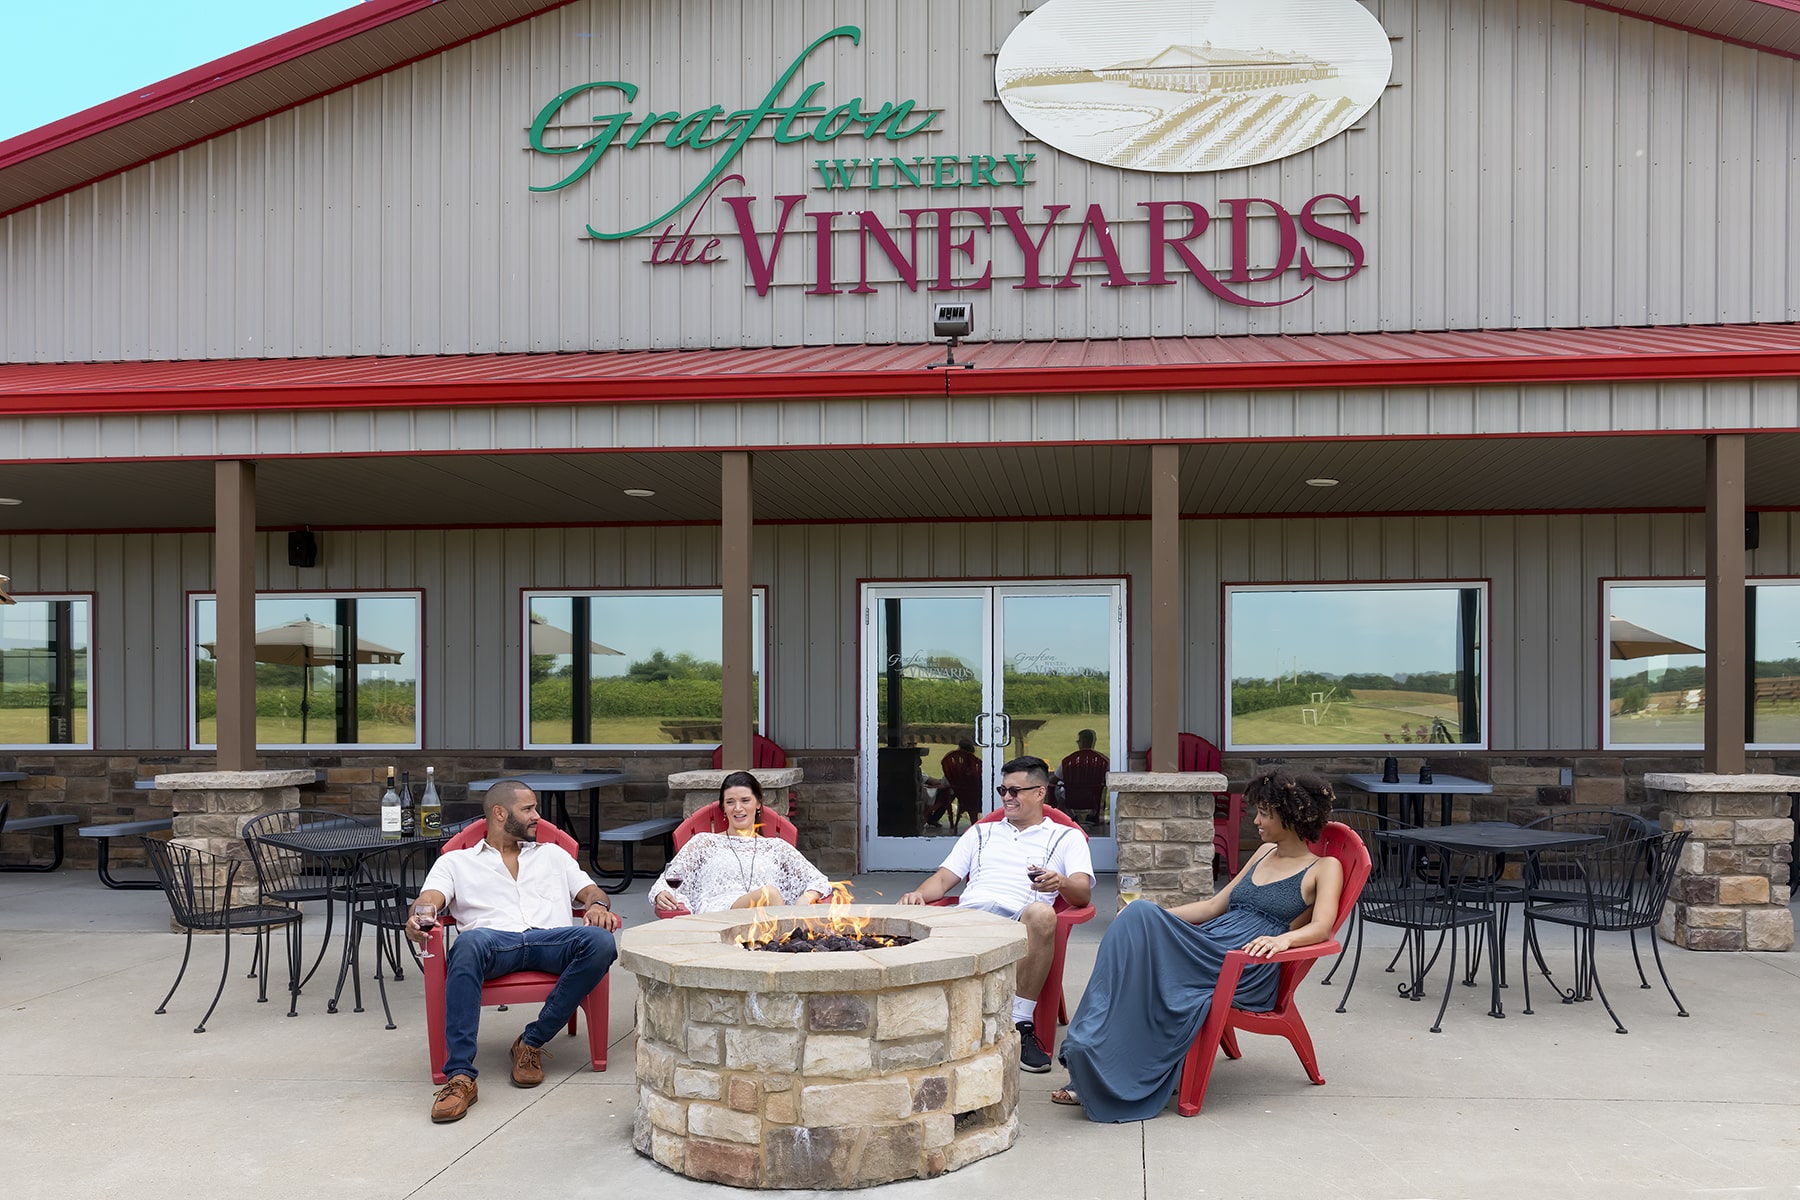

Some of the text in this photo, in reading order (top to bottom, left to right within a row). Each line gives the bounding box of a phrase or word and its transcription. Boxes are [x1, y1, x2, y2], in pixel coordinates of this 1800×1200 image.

[529, 26, 936, 240] Grafton
[816, 153, 1036, 191] WINERY
[651, 175, 1364, 307] the VINEYARDS
[1015, 648, 1056, 670] Grafton
